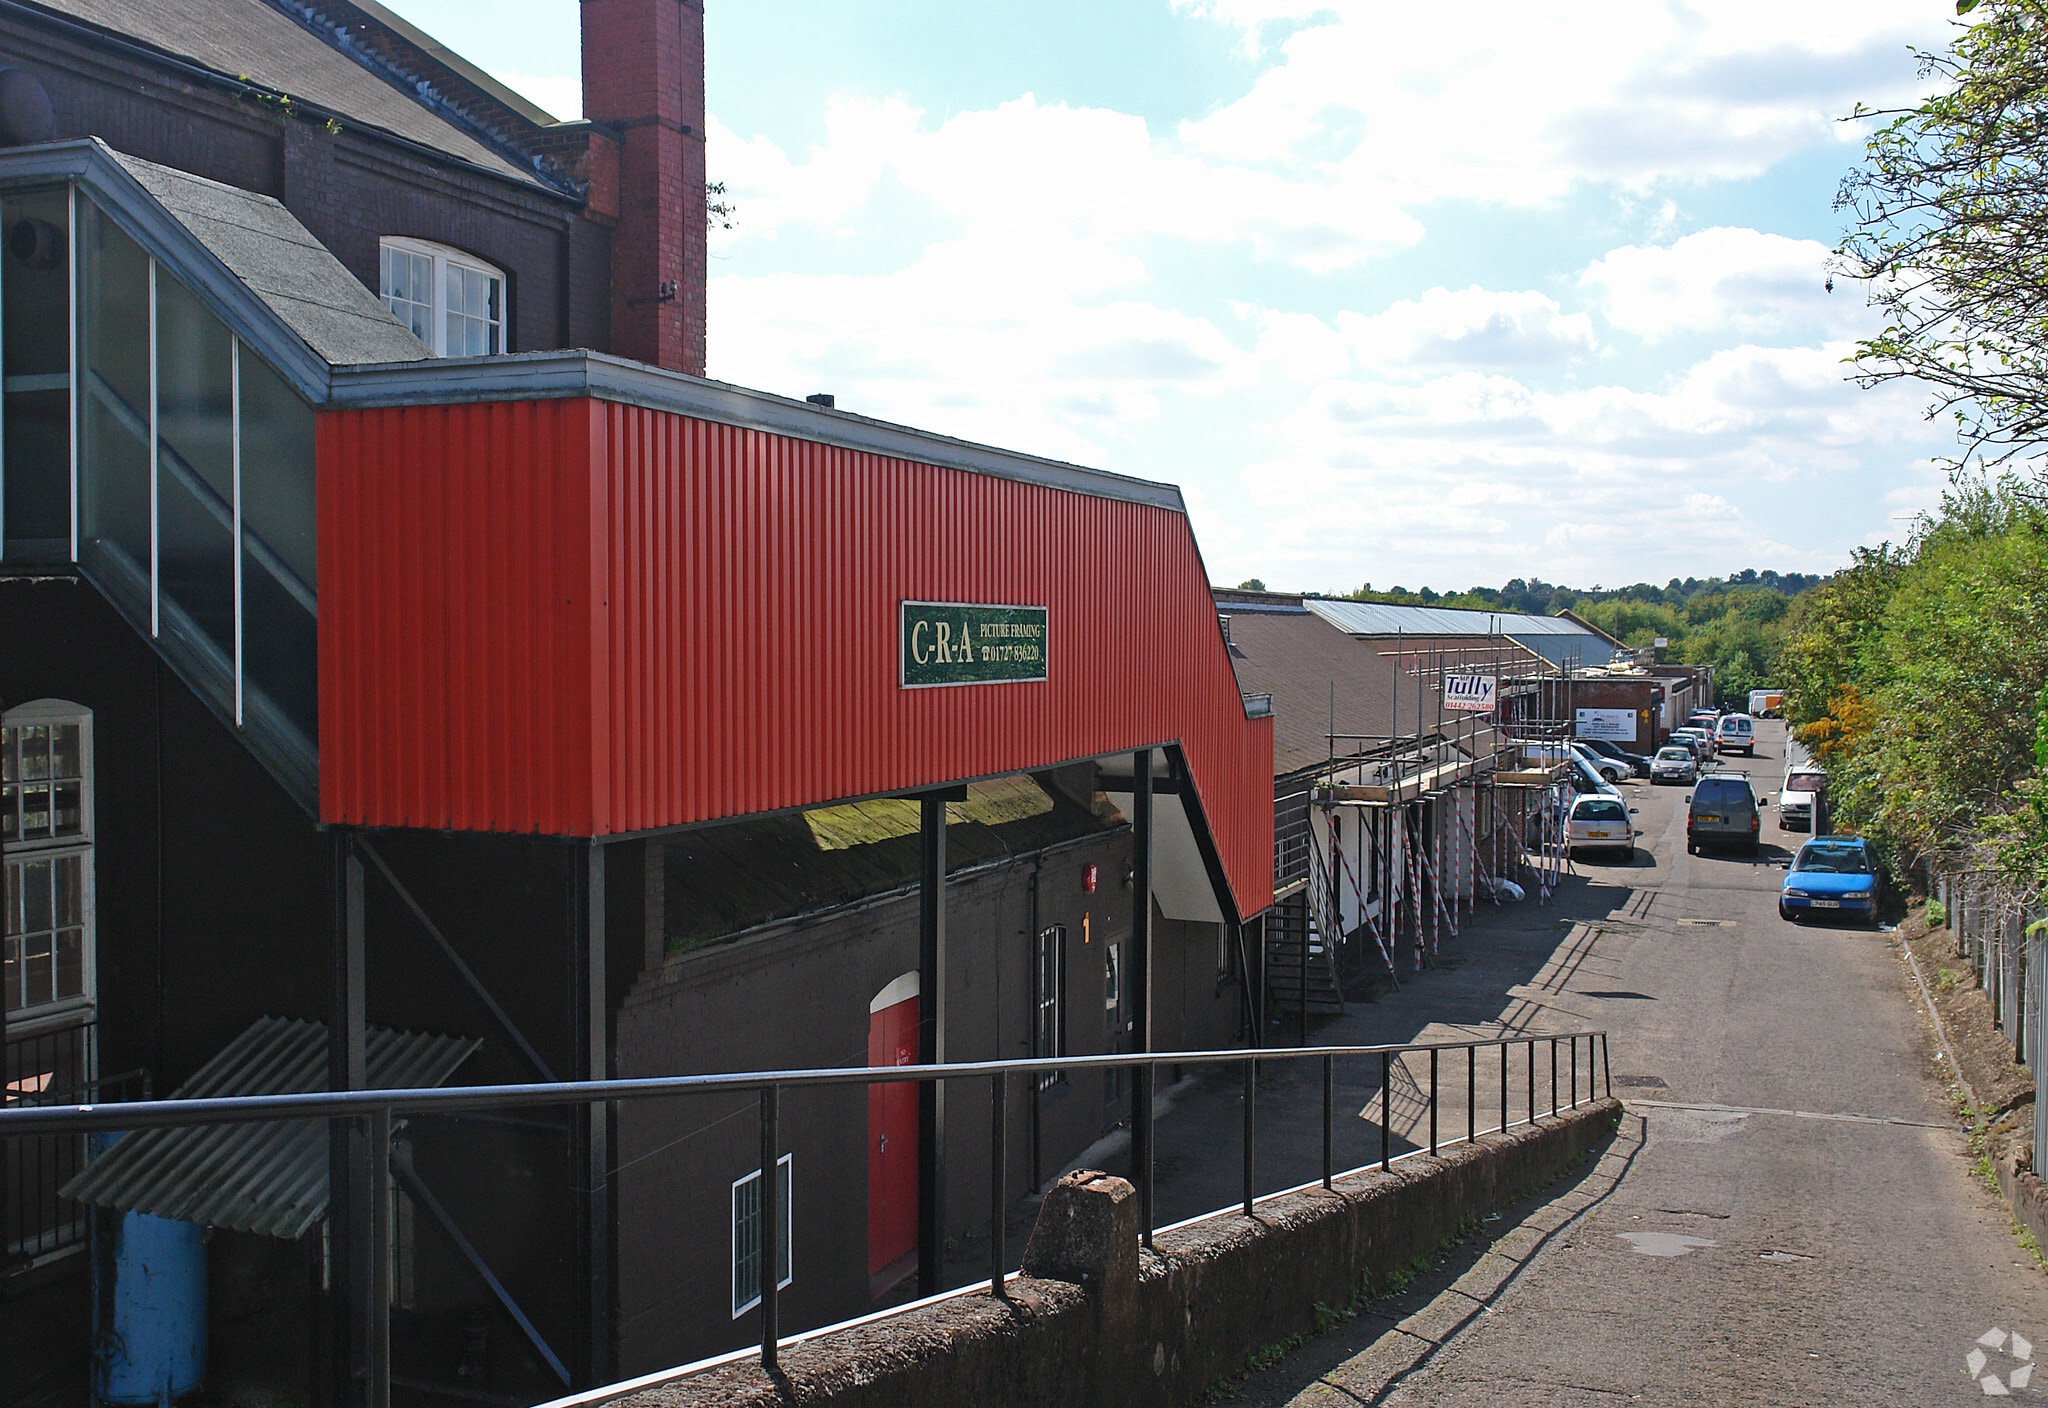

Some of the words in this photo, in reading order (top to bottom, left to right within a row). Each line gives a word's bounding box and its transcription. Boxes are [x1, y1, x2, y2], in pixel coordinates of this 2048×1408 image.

[980, 623, 1010, 638] PICTURE
[1010, 623, 1040, 638] FRAMING
[990, 645, 1012, 662] 01727
[1013, 643, 1039, 662] 836220
[1447, 676, 1493, 701] Tully
[1641, 709, 1649, 718] 4
[1083, 911, 1089, 944] 1
